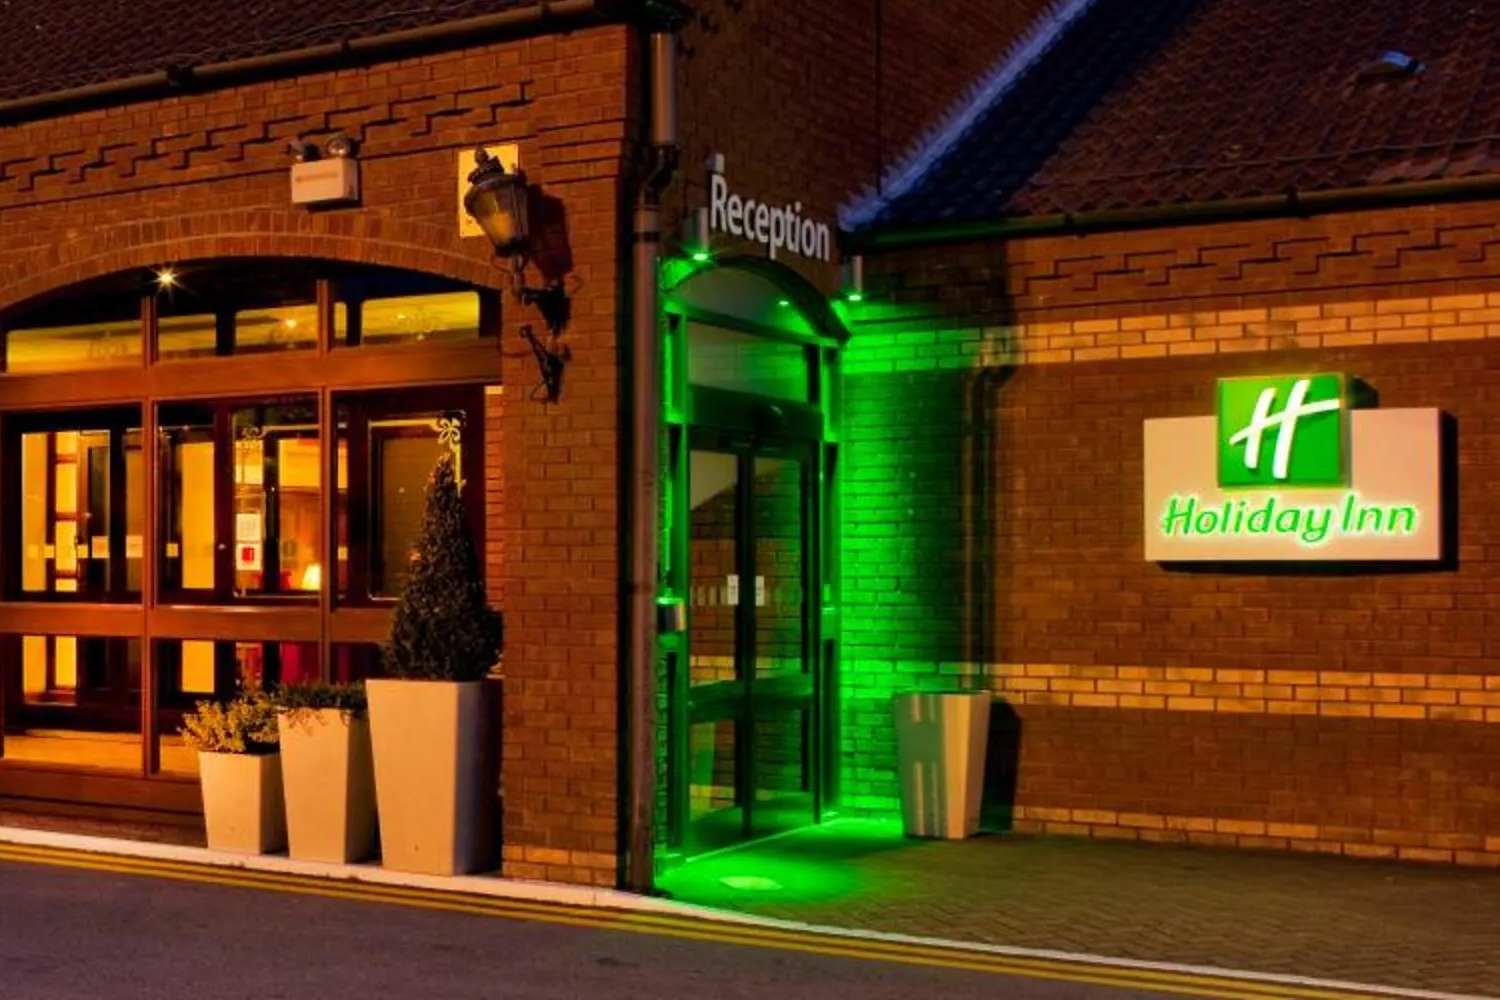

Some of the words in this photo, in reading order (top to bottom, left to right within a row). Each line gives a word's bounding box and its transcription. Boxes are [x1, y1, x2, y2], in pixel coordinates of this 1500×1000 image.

[709, 173, 830, 262] Reception
[1162, 495, 1332, 543] Holiday
[1342, 495, 1416, 532] Inn
